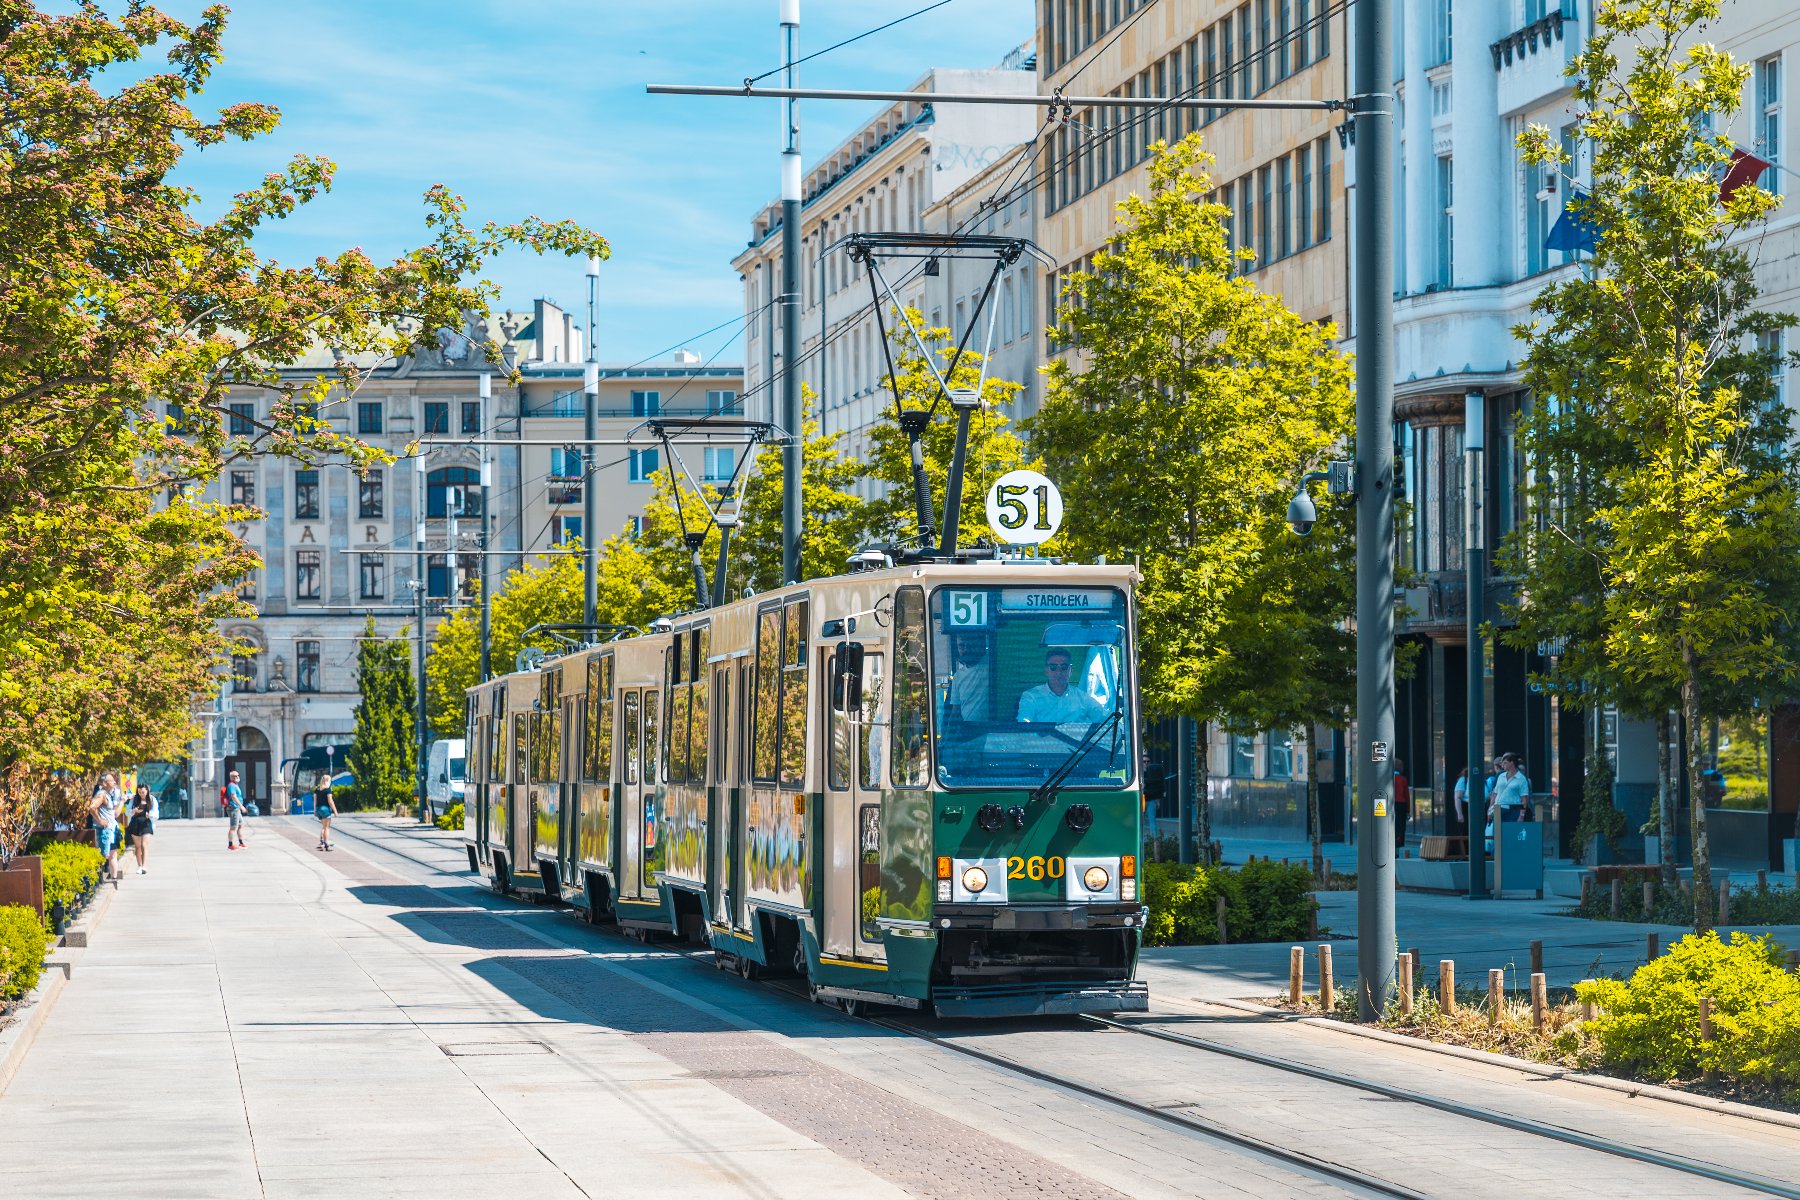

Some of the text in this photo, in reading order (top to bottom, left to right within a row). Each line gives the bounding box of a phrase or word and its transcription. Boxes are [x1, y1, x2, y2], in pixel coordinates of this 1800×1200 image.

[997, 485, 1052, 530] 51
[953, 593, 983, 624] 51
[1007, 855, 1065, 881] 260
